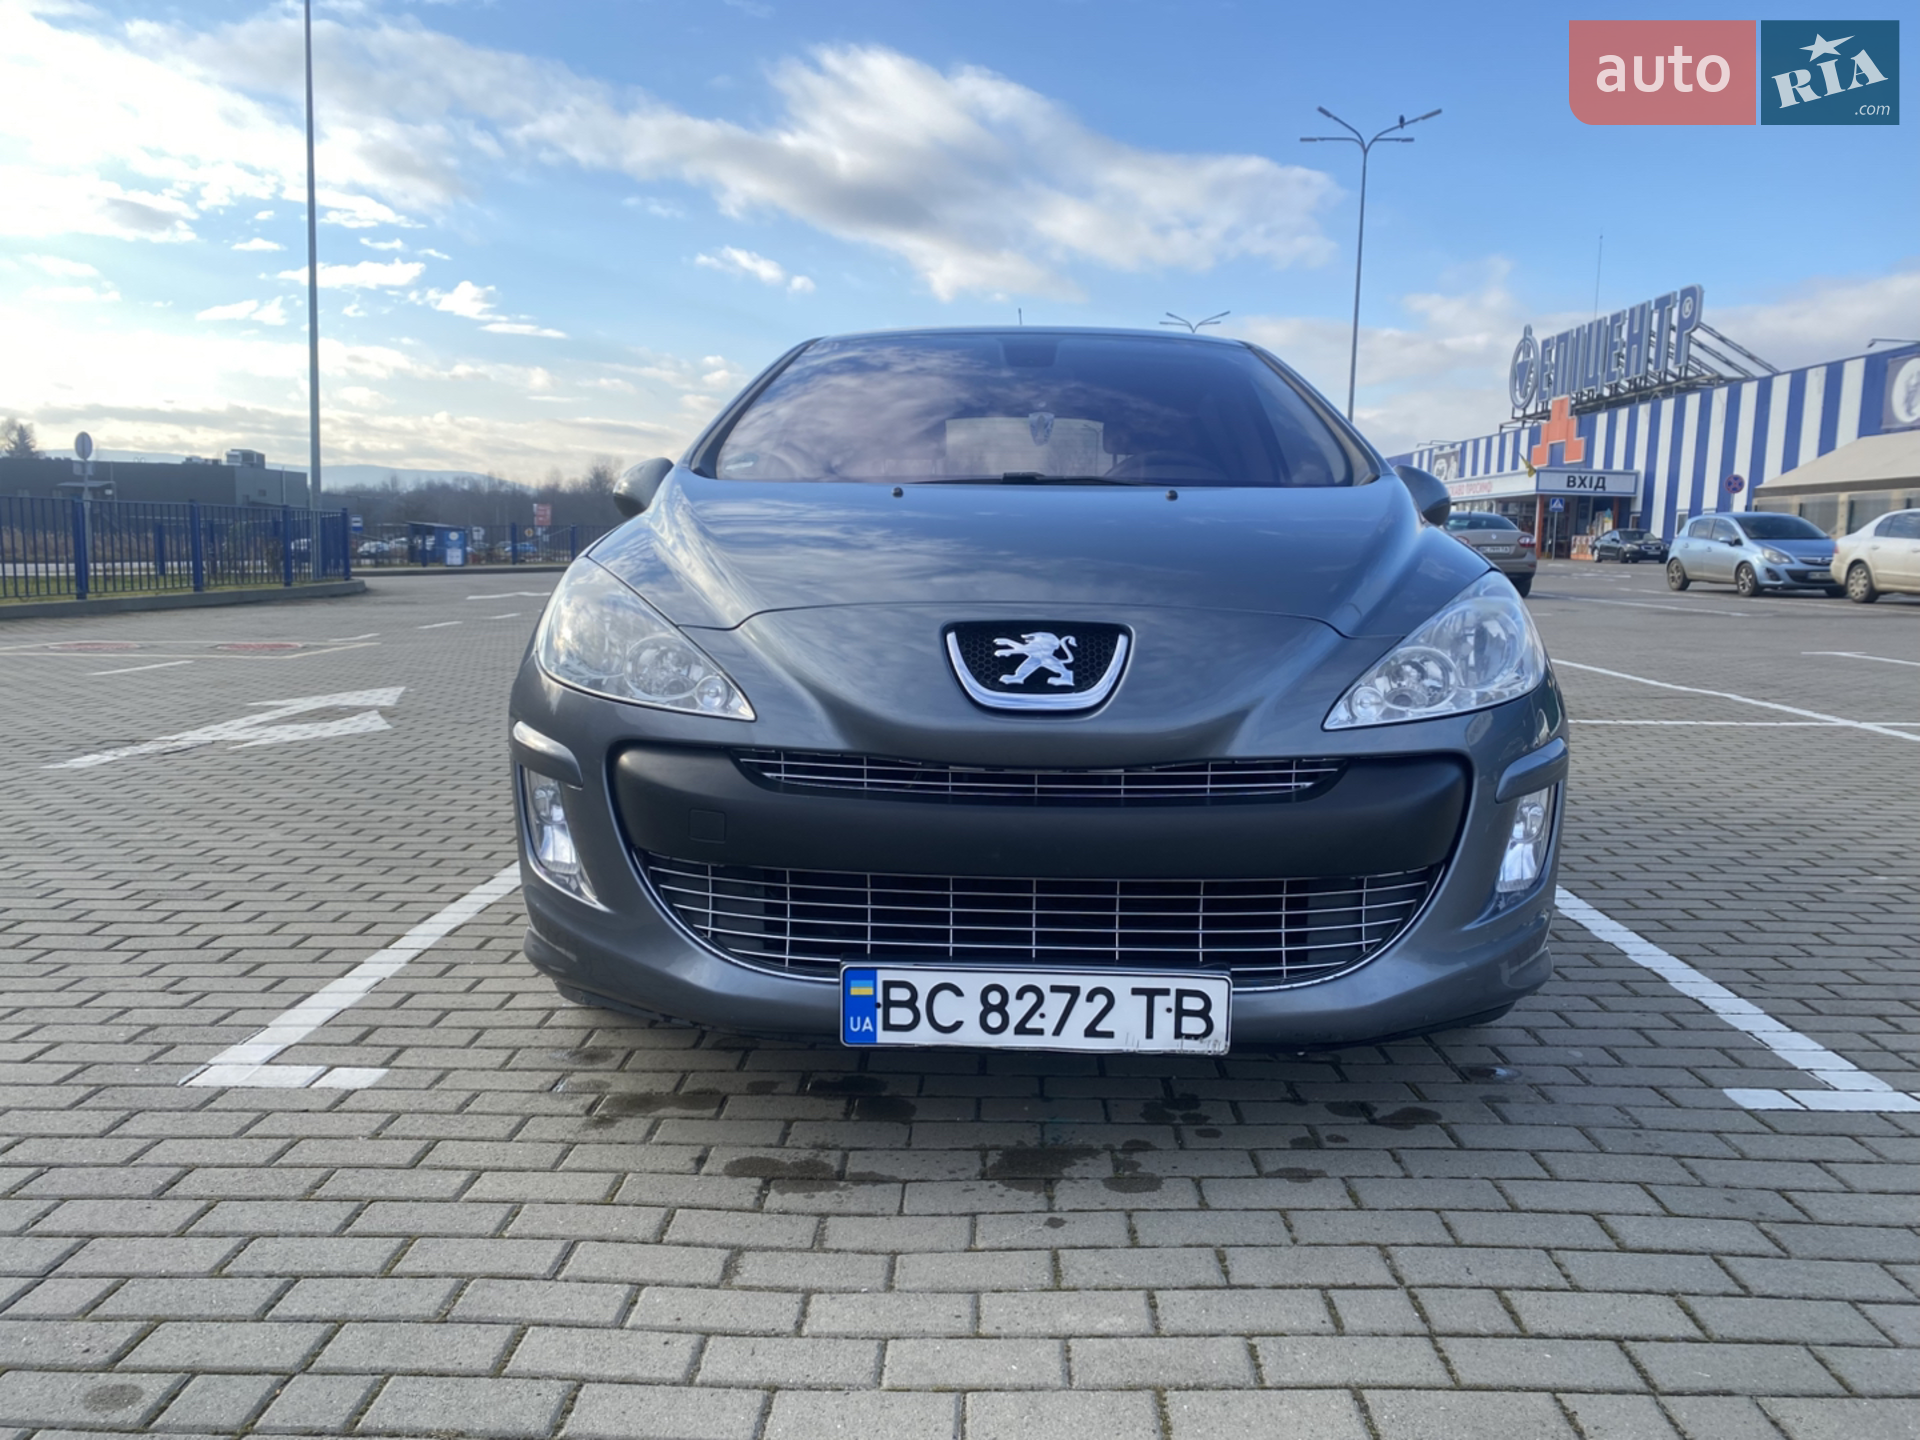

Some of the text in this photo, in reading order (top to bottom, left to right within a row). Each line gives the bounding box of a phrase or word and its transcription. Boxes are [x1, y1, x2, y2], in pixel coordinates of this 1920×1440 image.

[1537, 284, 1704, 402] ЕПІЦЕНТР
[1566, 475, 1606, 491] ВХІД
[849, 1016, 874, 1032] UA
[882, 980, 1214, 1040] BC 8272 TB
